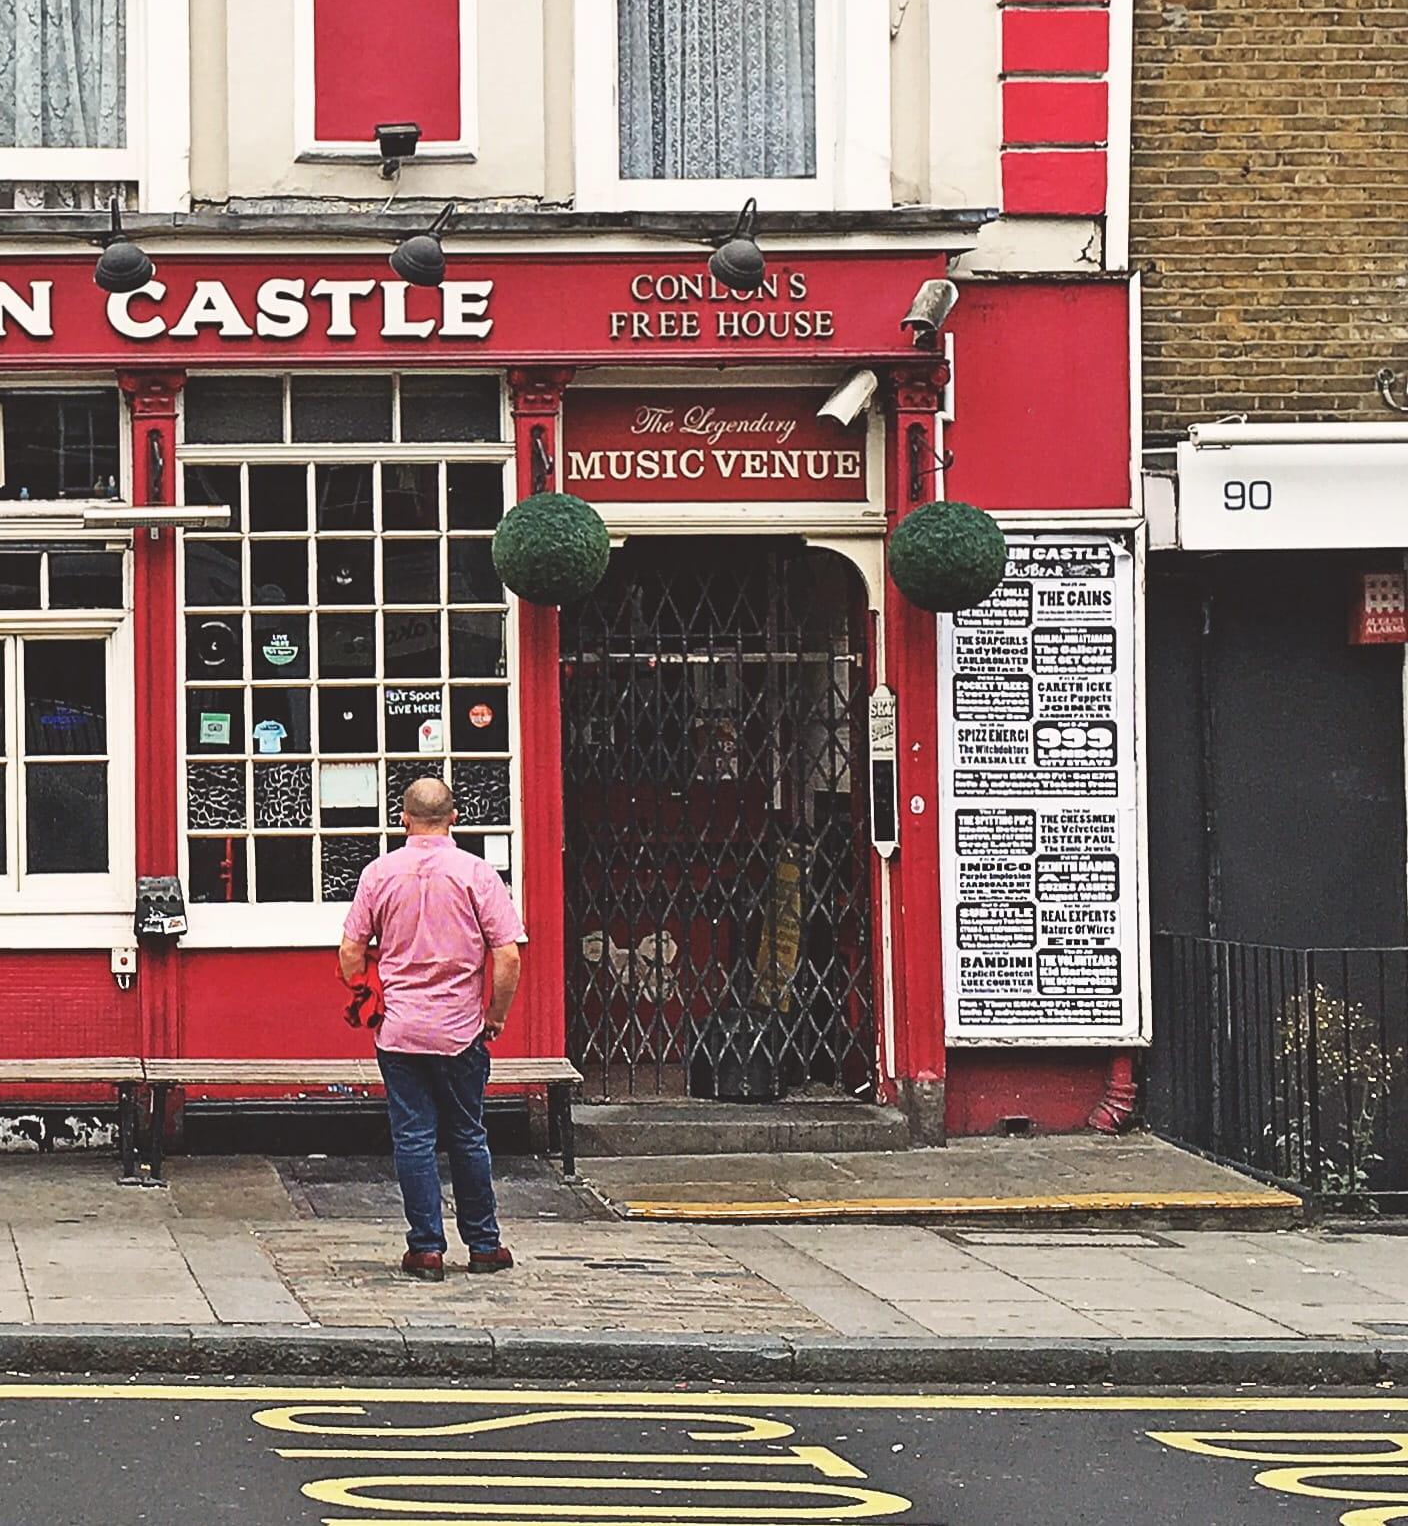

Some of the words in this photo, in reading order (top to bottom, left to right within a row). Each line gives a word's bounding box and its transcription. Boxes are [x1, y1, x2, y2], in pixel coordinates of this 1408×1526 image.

[106, 278, 493, 338] CASTLE
[609, 311, 701, 337] FREE
[716, 310, 834, 337] HOUSE
[631, 405, 674, 434] The
[679, 405, 796, 445] Legendary
[568, 449, 705, 480] MUSIC
[712, 449, 861, 480] VENUE
[1224, 480, 1272, 511] 90
[1033, 548, 1110, 560] CASTLE
[1037, 591, 1065, 606] THE
[956, 636, 973, 645] THE
[409, 690, 440, 702] Sport
[389, 705, 411, 715] LIVE
[414, 705, 441, 714] HERE
[1036, 727, 1113, 748] 999
[1040, 815, 1058, 824] THE
[1084, 835, 1116, 844] PAUL
[1041, 910, 1067, 922] REAL
[960, 957, 1033, 968] BANDINI
